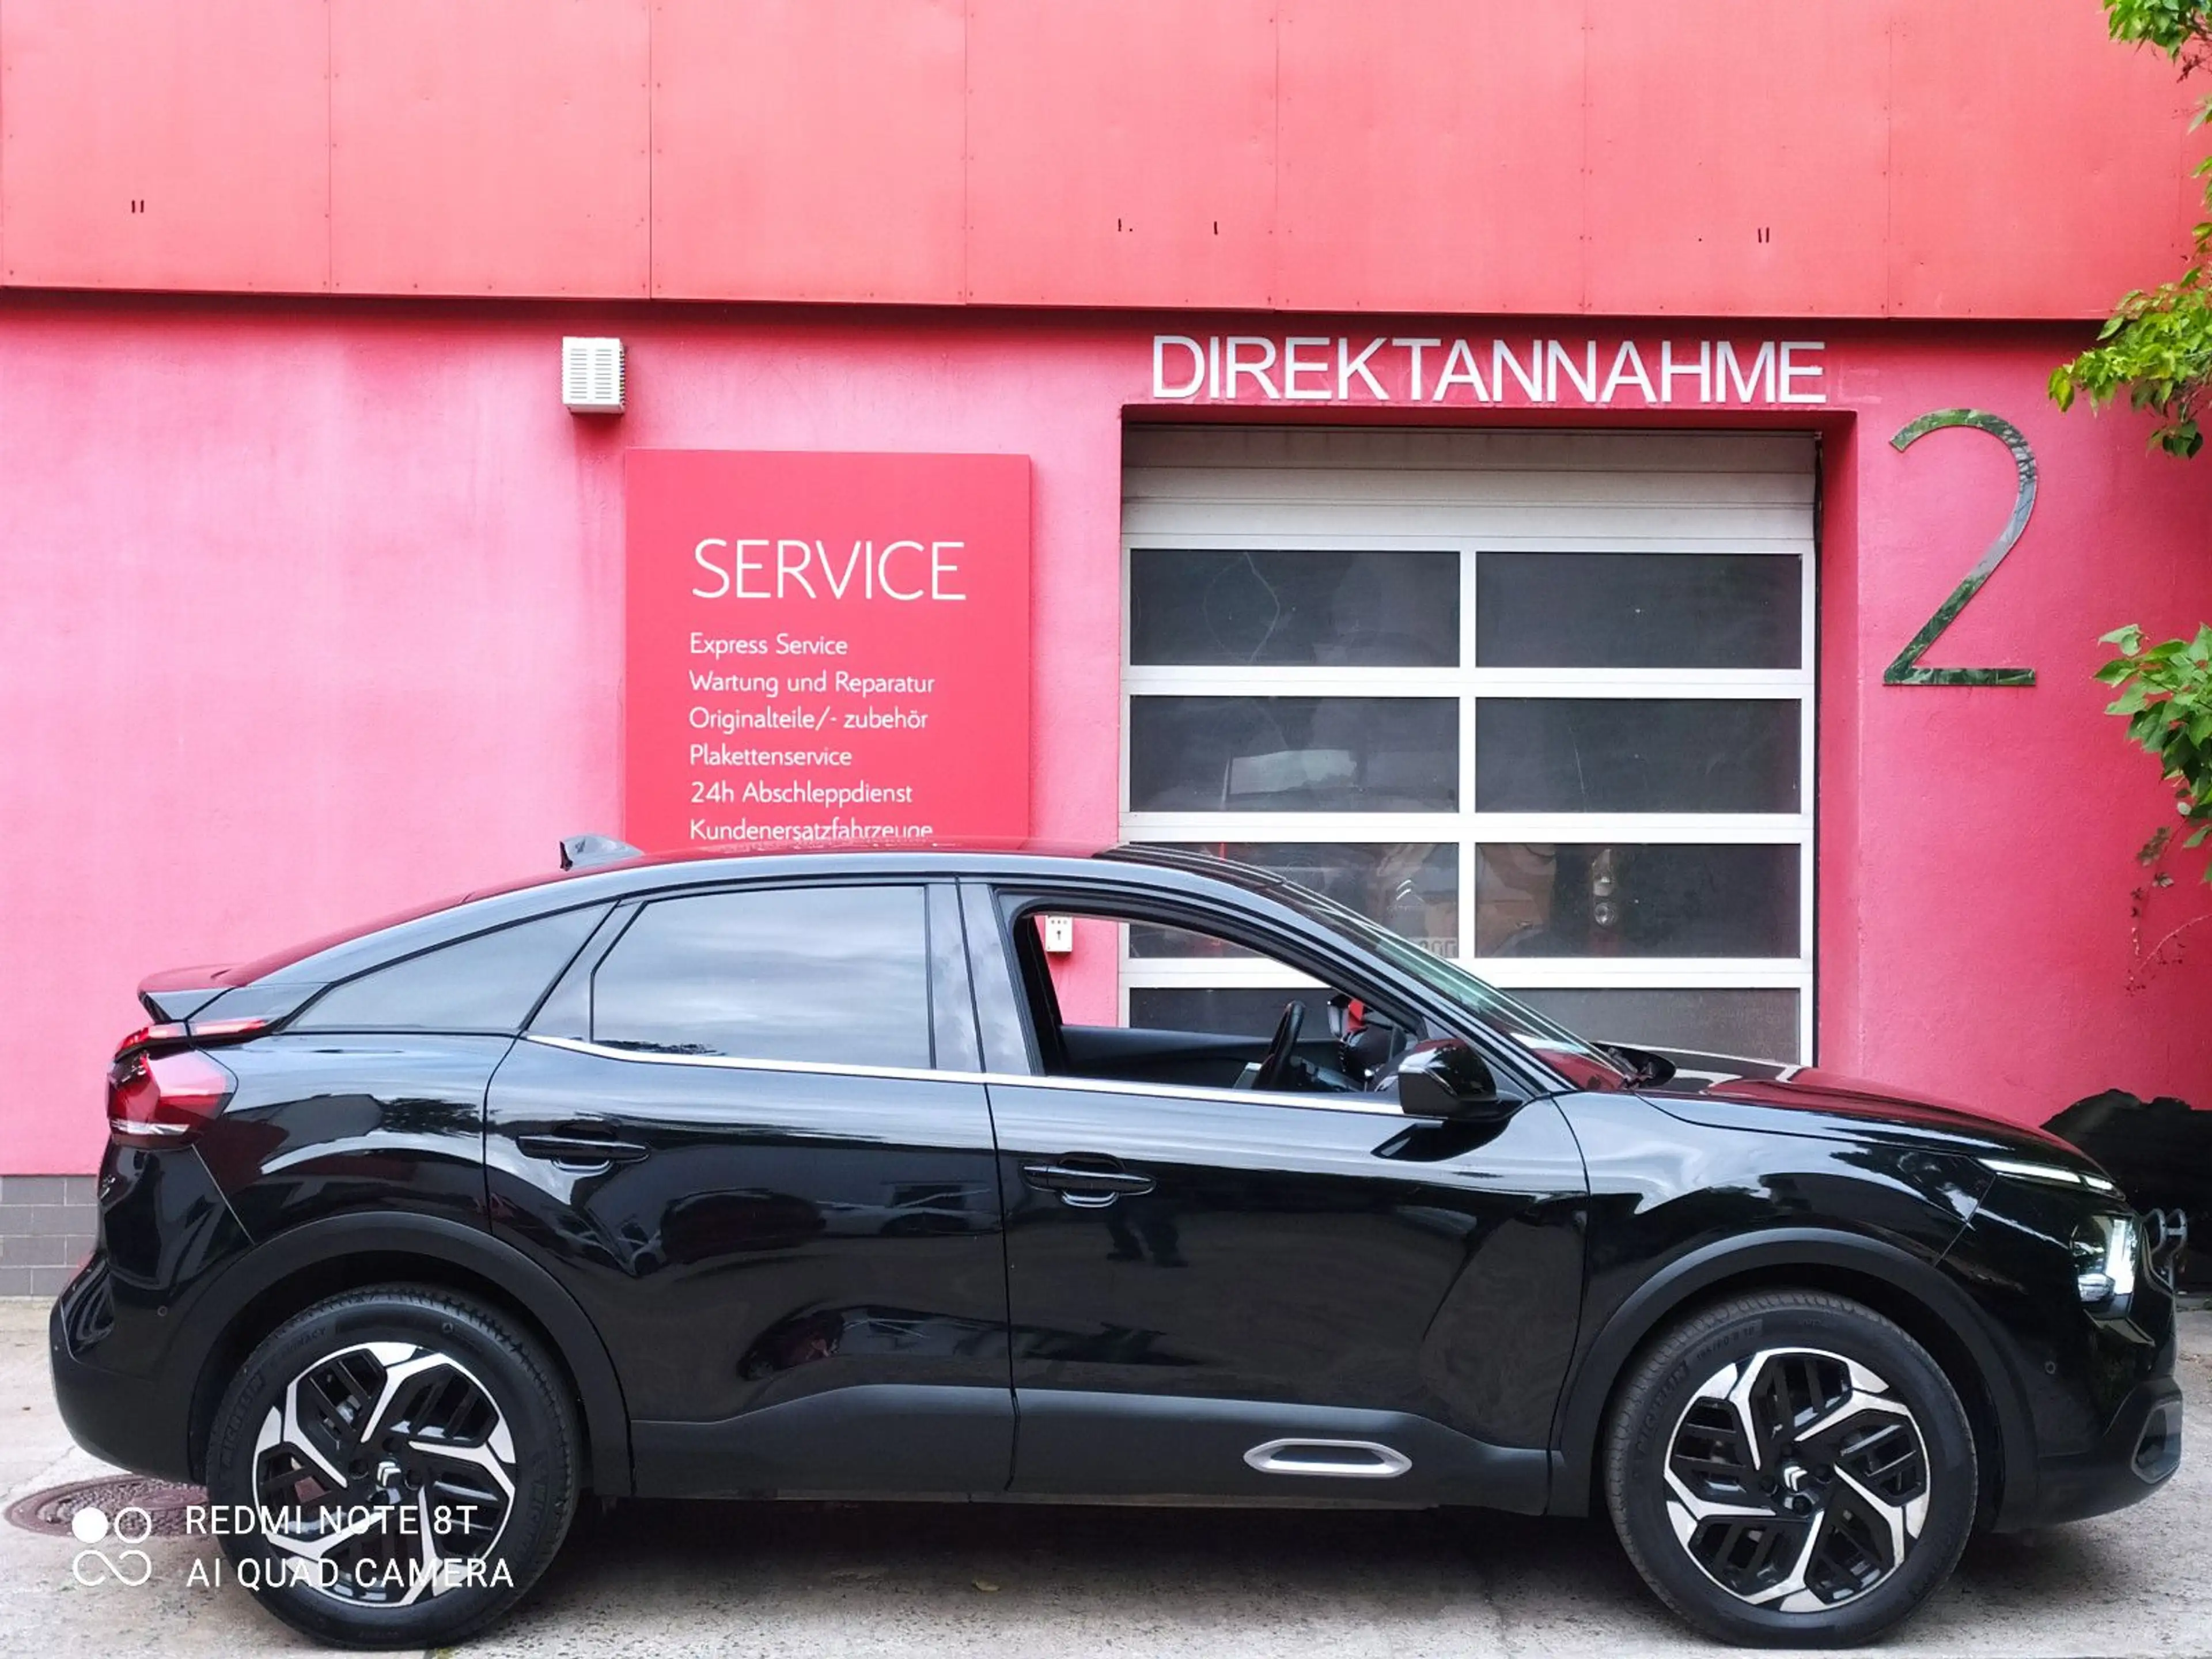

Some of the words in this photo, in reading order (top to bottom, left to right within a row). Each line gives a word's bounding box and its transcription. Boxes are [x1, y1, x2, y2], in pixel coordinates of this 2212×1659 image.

[1153, 335, 1827, 404] DIREKTANNAHME
[1883, 408, 2037, 687] 2
[692, 538, 966, 601] SERVICE
[690, 632, 768, 660] Express
[775, 632, 848, 656] Service
[688, 670, 779, 698] Wartung
[787, 670, 827, 692] und
[835, 671, 935, 698] Reparatur
[689, 705, 837, 735] Originalteile/-
[843, 706, 929, 729] zubehör
[690, 743, 853, 766] Plakettenservice
[691, 779, 734, 803] 24h
[742, 779, 912, 808] Abschleppdienst
